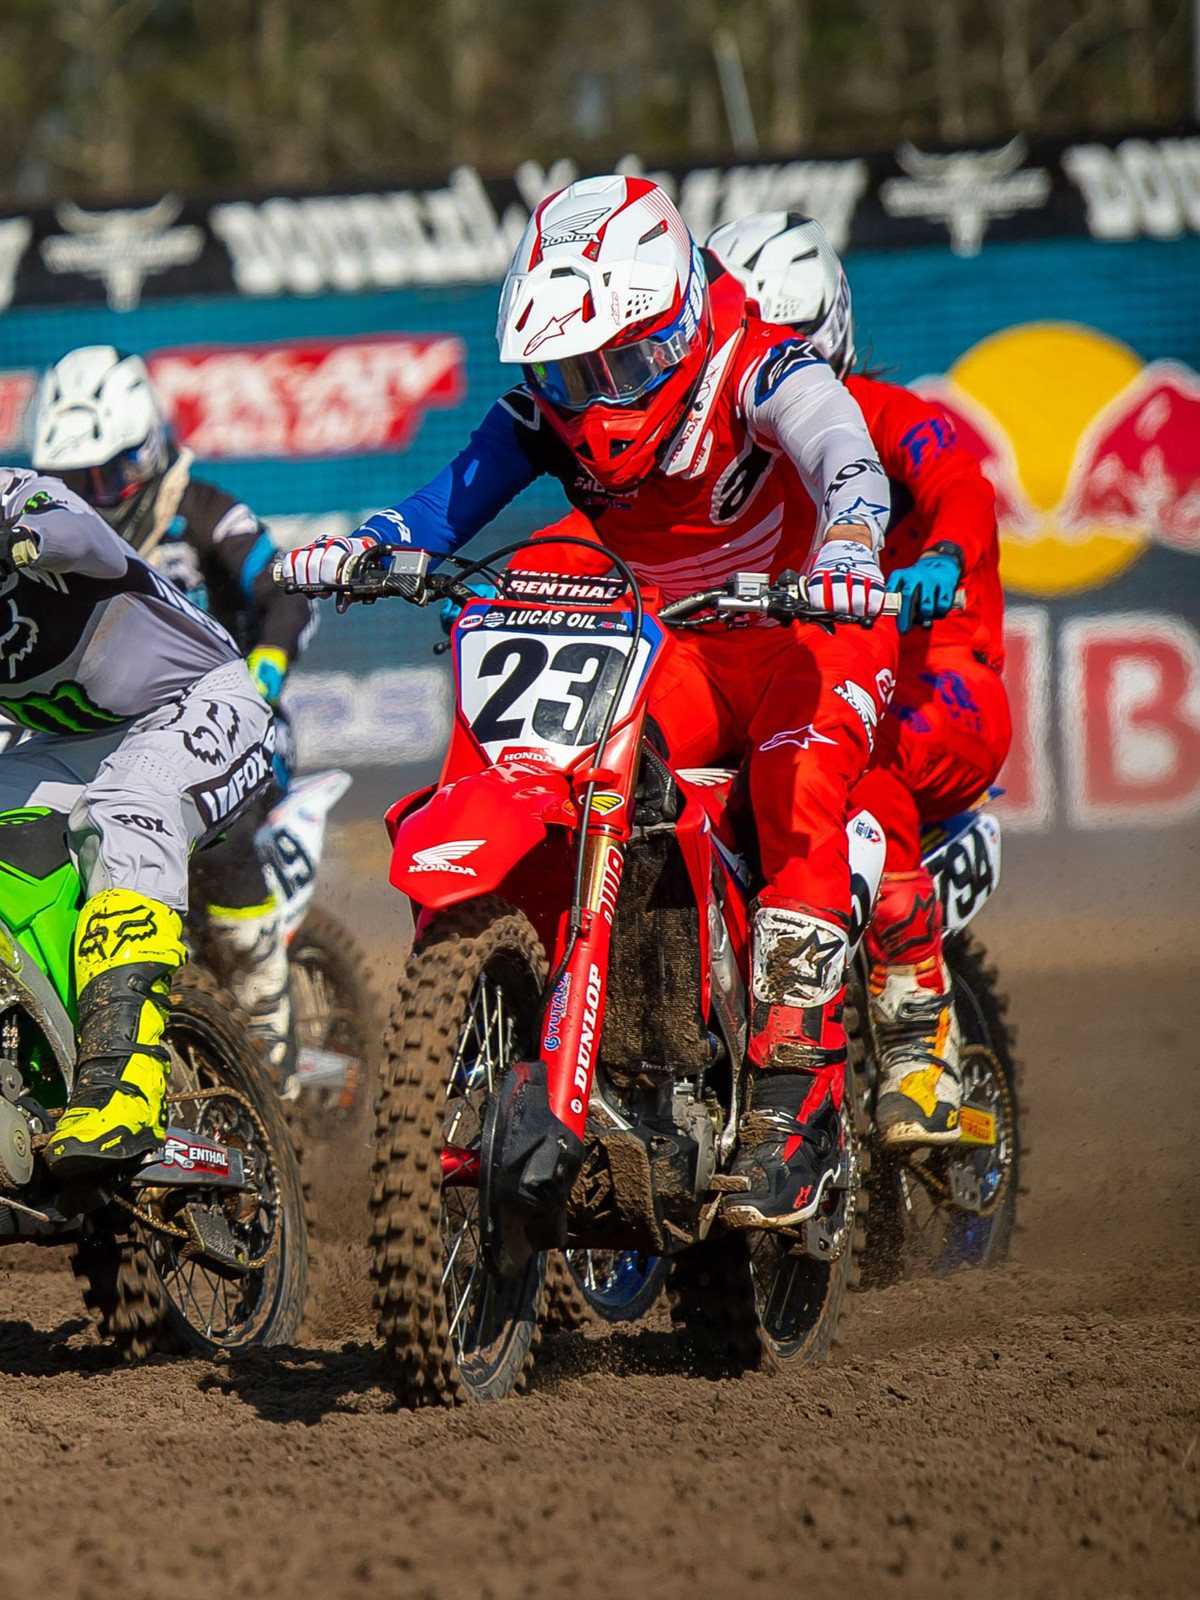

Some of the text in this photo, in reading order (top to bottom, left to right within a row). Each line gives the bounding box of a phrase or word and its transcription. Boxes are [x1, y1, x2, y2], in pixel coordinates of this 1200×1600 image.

[540, 232, 600, 248] HONDA
[506, 580, 621, 599] RENTHAL
[506, 610, 597, 629] LUCAS OIL
[469, 638, 629, 747] 23
[503, 752, 552, 764] HONDA
[111, 814, 174, 837] FOX
[408, 863, 477, 877] HONDA
[573, 963, 602, 1094] DUNLOP
[165, 1139, 229, 1169] RENTHAL
